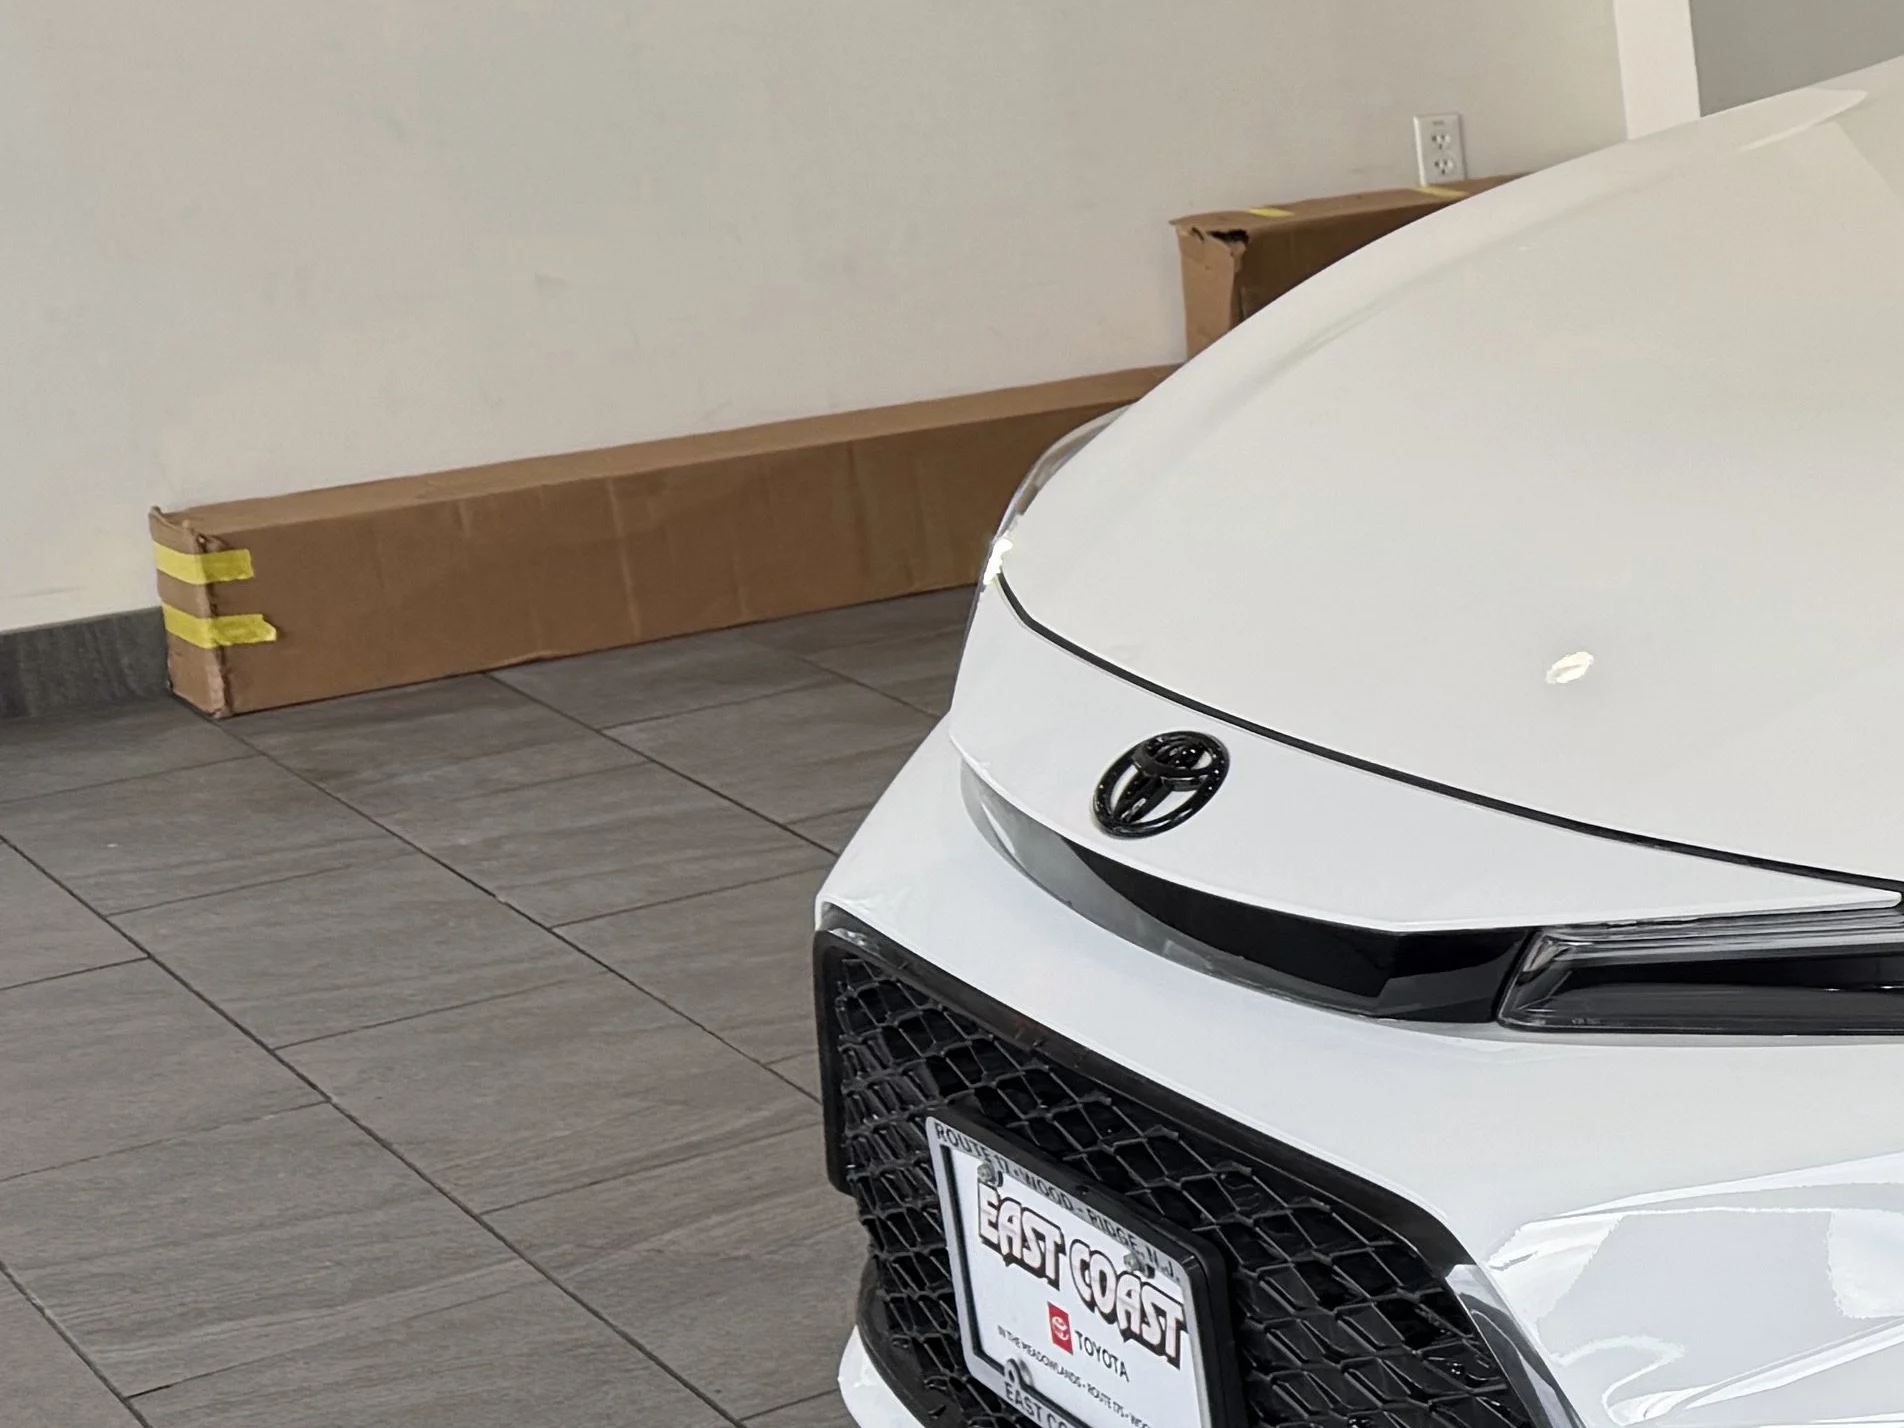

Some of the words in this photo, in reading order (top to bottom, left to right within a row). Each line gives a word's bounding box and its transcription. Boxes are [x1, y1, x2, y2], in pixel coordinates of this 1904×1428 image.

[934, 1122, 992, 1162] ROUTE
[1024, 1173, 1073, 1211] WOOD
[978, 1181, 1067, 1291] EAST
[1069, 1238, 1189, 1370] COAST
[1075, 1329, 1130, 1382] TOYOTA
[1004, 1381, 1042, 1423] EAST
